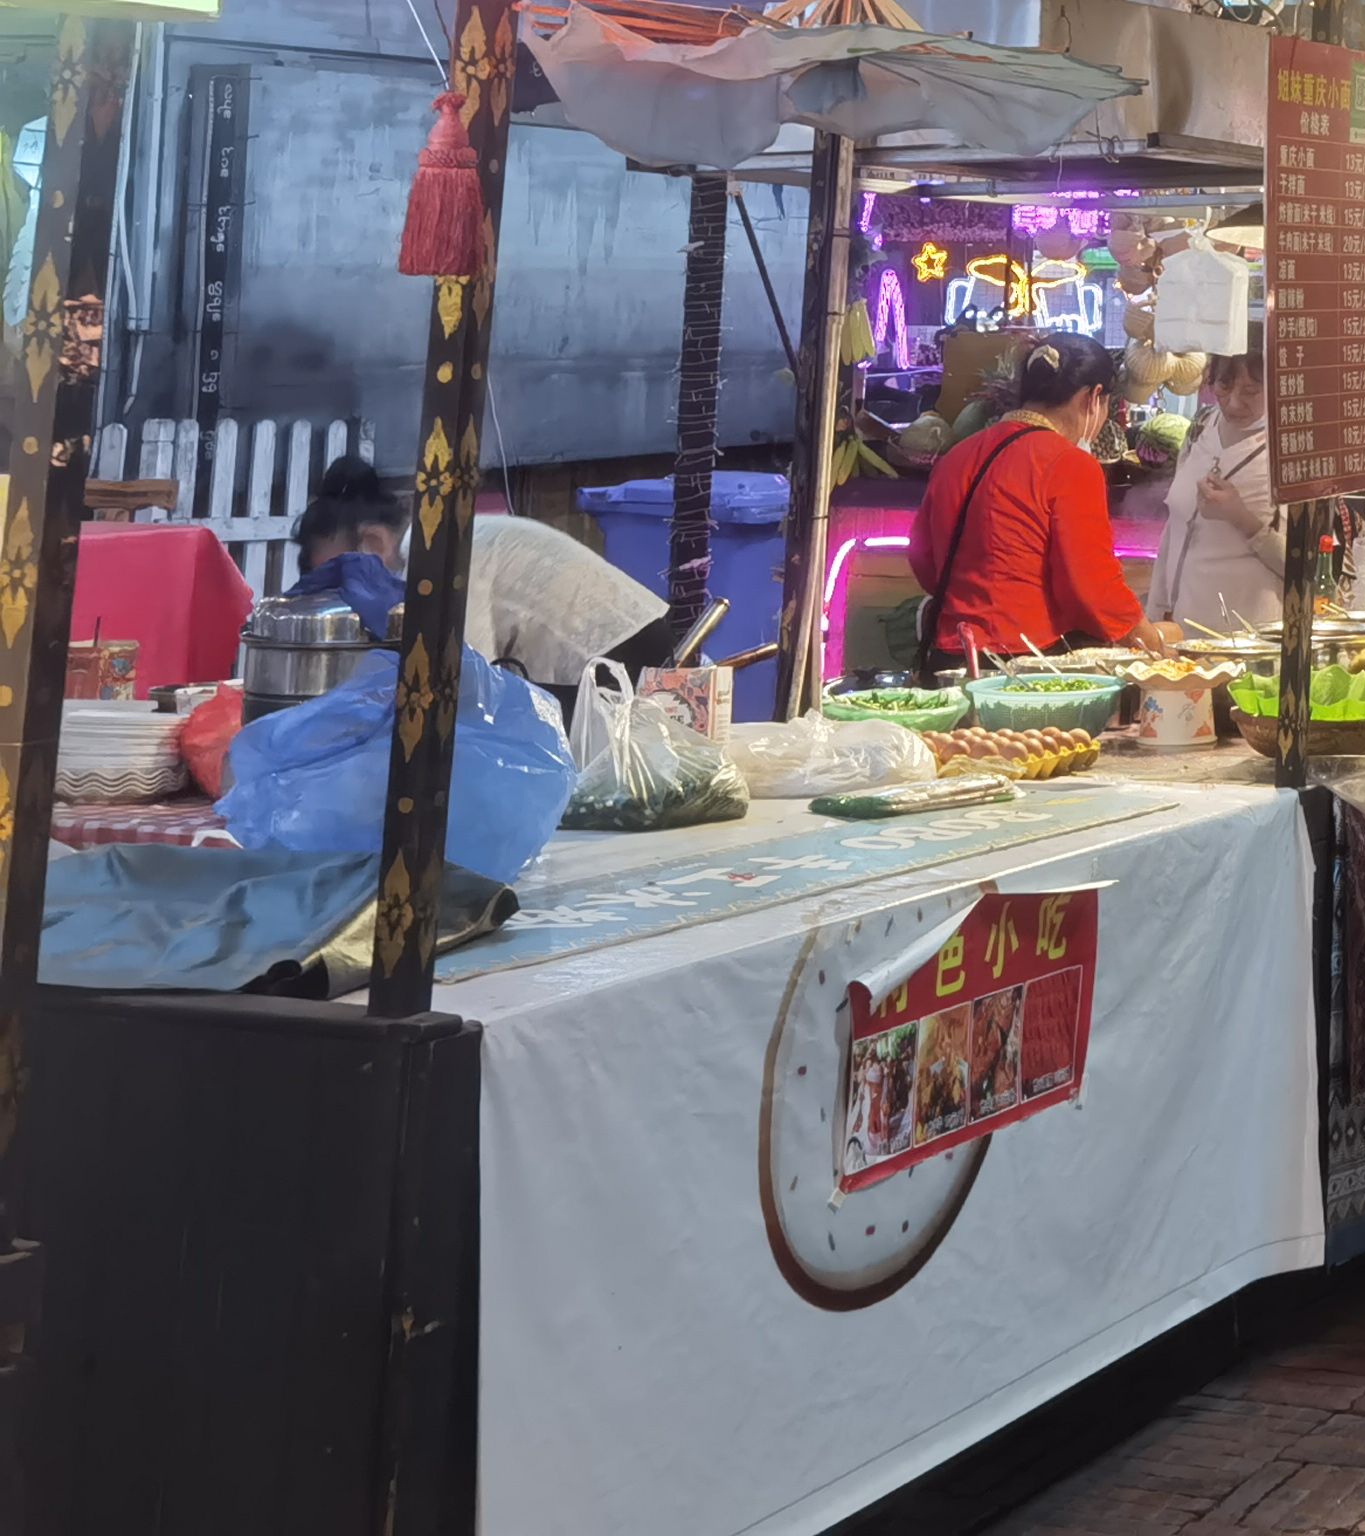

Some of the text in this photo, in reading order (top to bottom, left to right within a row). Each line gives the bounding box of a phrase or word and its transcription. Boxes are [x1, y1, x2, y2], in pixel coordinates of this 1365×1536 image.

[1277, 68, 1351, 110] 姐妹重庆小面
[1300, 111, 1330, 136] 价格表
[1279, 145, 1316, 169] 重庆小面
[1279, 374, 1305, 396] 蛋炒饭
[879, 896, 1071, 1019] 色小吃
